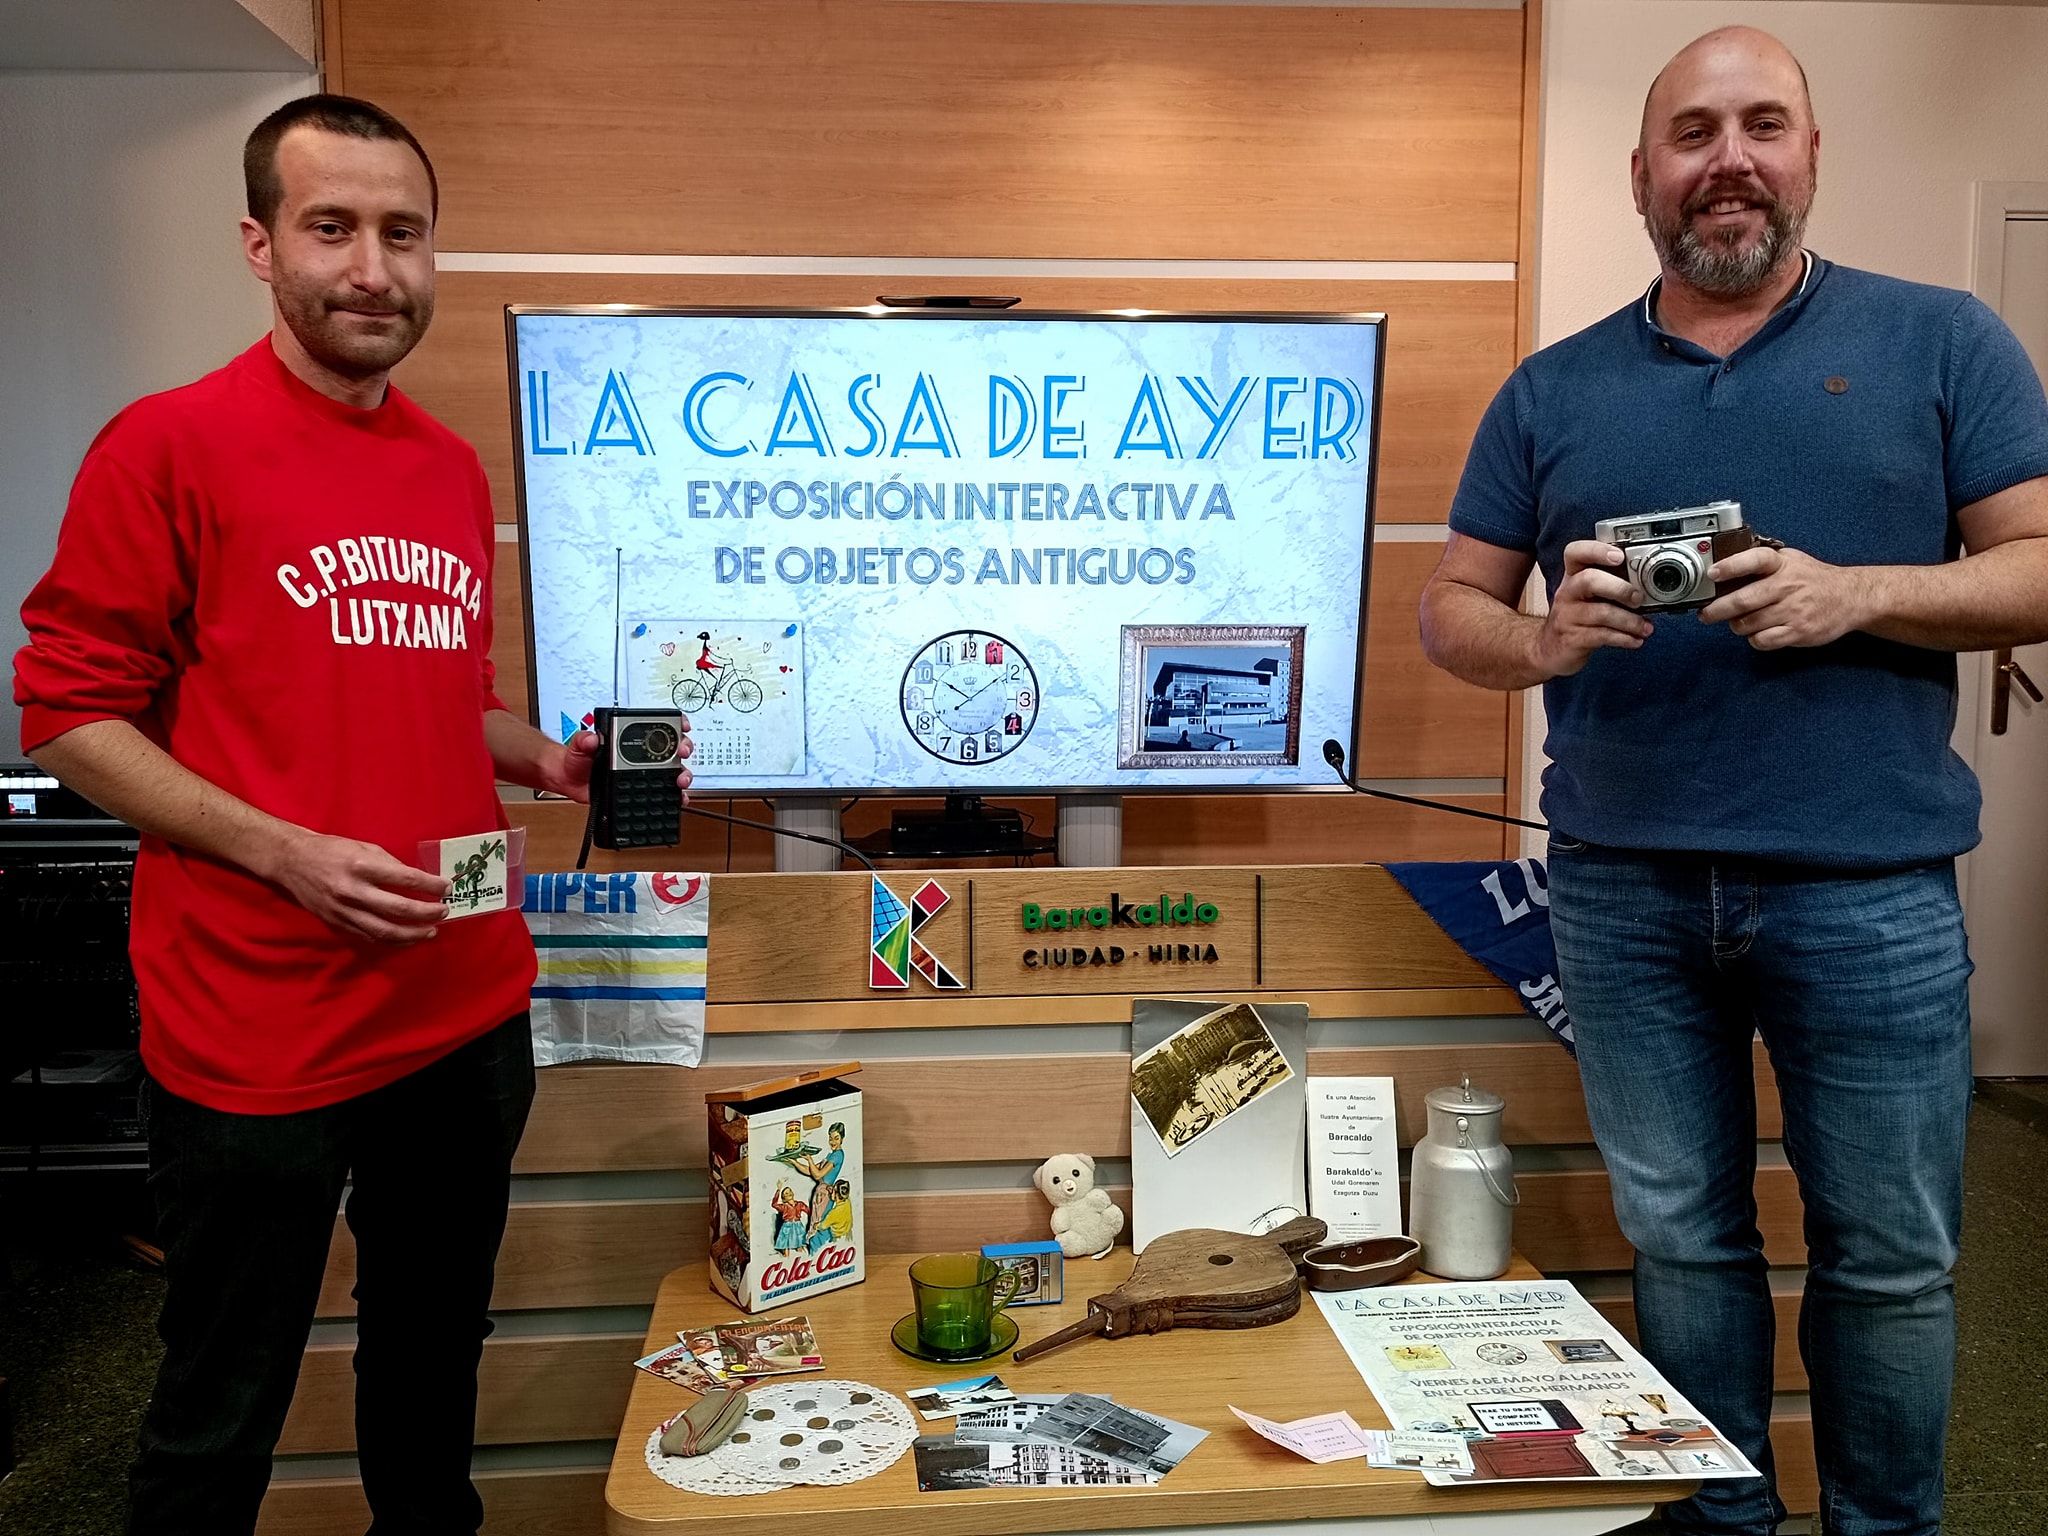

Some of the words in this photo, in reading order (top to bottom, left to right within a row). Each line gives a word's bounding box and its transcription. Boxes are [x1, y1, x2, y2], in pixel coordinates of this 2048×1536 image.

[527, 368, 656, 457] LA
[683, 370, 962, 459] CASA
[989, 373, 1087, 460] DE
[1115, 375, 1366, 463] AYER
[686, 473, 946, 522] EXPOSICIÓN
[953, 480, 1236, 522] INTERACTIVA
[713, 546, 768, 585] DE
[774, 546, 965, 586] OBJETOS
[974, 546, 1197, 586] ANTIGUOS
[329, 597, 468, 650] LUTXANA
[962, 641, 977, 658] 12
[918, 667, 931, 681] 10
[1010, 664, 1021, 681] 2
[1018, 691, 1031, 708] 3
[919, 715, 931, 730] 8
[1006, 717, 1020, 735] 4
[939, 736, 952, 752] 7
[962, 742, 975, 759] 6
[988, 734, 998, 750] 5
[1022, 892, 1220, 930] Barakaldo
[1022, 947, 1126, 968] CIUDAD
[1148, 943, 1220, 964] HIRIA
[1328, 1132, 1373, 1142] Baracaldo
[760, 1245, 856, 1291] Cola-Cao
[1335, 1298, 1373, 1311] LA
[1378, 1295, 1456, 1309] CASA
[1458, 1293, 1491, 1306] DE
[1389, 1322, 1472, 1332] EXPOSICIÓN
[1472, 1319, 1563, 1329] INTERACTIVA
[1403, 1333, 1422, 1341] DE
[1423, 1331, 1485, 1340] OBJETOS
[1487, 1328, 1559, 1338] ANTIGUOS
[1410, 1378, 1470, 1387] VIERNES
[1482, 1376, 1502, 1385] DE
[1502, 1374, 1555, 1384] MAYO
[1570, 1372, 1601, 1381] LAS
[1622, 1371, 1637, 1379] H
[1422, 1389, 1444, 1398] EN
[1444, 1389, 1463, 1397] EL
[1490, 1386, 1508, 1395] DE
[1509, 1385, 1541, 1394] LOS
[1541, 1382, 1631, 1392] HERMANOS
